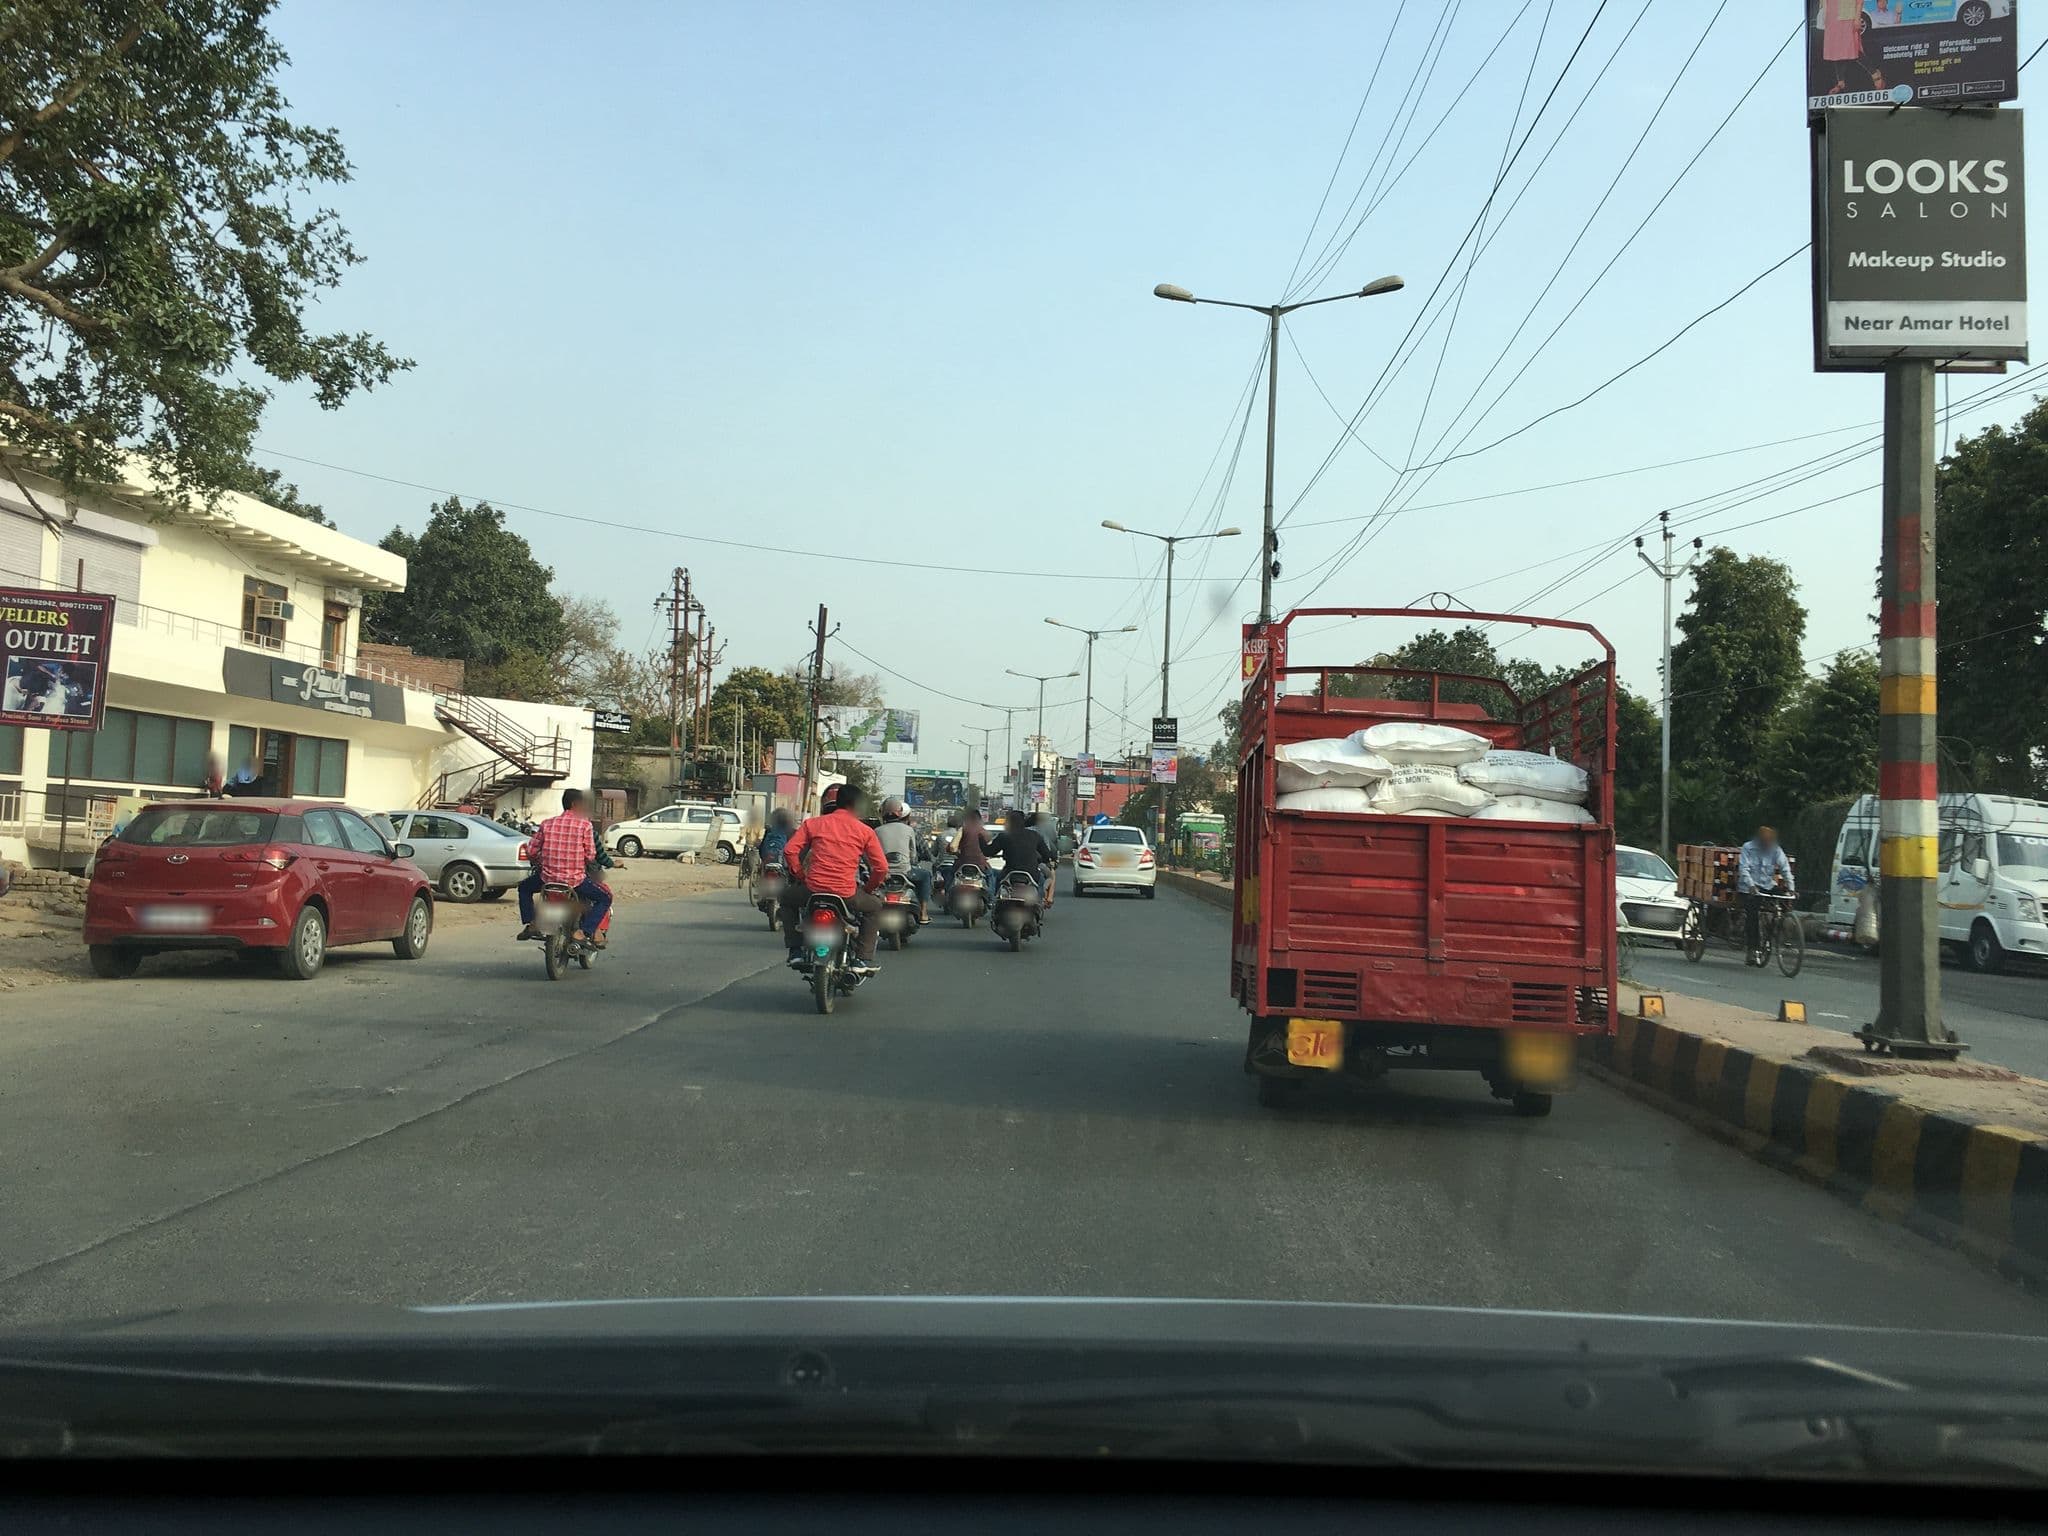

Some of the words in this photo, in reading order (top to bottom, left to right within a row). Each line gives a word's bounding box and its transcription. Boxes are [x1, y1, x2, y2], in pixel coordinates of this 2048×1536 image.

[1813, 91, 1889, 107] 7806060606
[1843, 158, 2009, 194] LOOKS
[1846, 201, 2008, 219] SALON
[1847, 250, 1934, 272] Makeup
[1940, 250, 2007, 268] Studio
[1844, 315, 1893, 331] Near
[1899, 315, 1953, 331] Amar
[1959, 315, 2009, 331] Hotel
[5, 628, 96, 656] OUTLET
